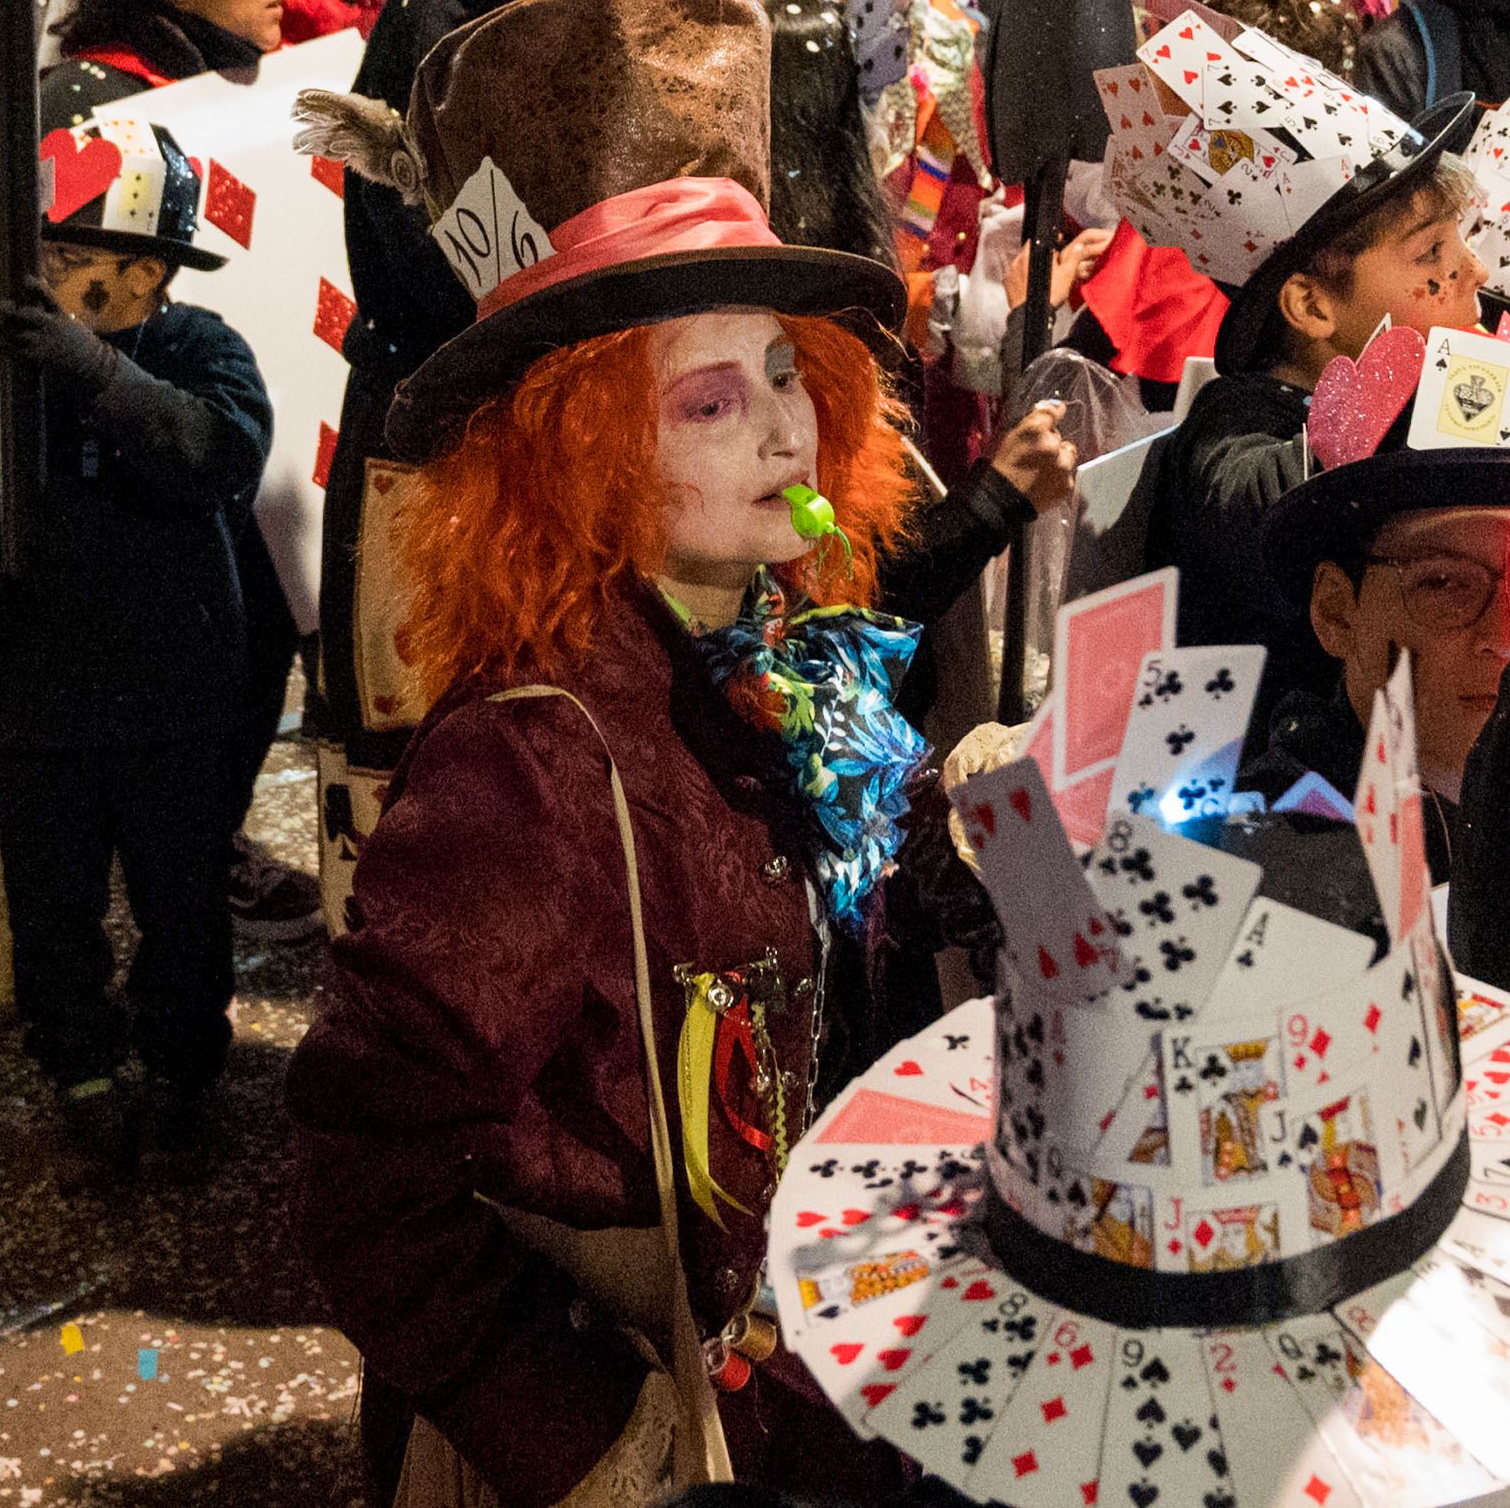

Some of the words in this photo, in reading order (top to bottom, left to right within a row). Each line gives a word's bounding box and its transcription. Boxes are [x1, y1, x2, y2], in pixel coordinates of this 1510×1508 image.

[1241, 162, 1253, 176] 2
[1437, 338, 1451, 356] A
[1143, 659, 1163, 687] 5
[1107, 820, 1133, 853] 8
[1248, 911, 1269, 947] A
[1287, 1013, 1309, 1048] 9
[1171, 1035, 1193, 1071] K
[1269, 1109, 1286, 1143] J
[1164, 1196, 1183, 1231] J
[999, 1292, 1029, 1318] 8
[1054, 1320, 1081, 1348] 6
[1278, 1333, 1304, 1360] Q
[1122, 1339, 1145, 1368] 9
[1210, 1343, 1238, 1373] 2
